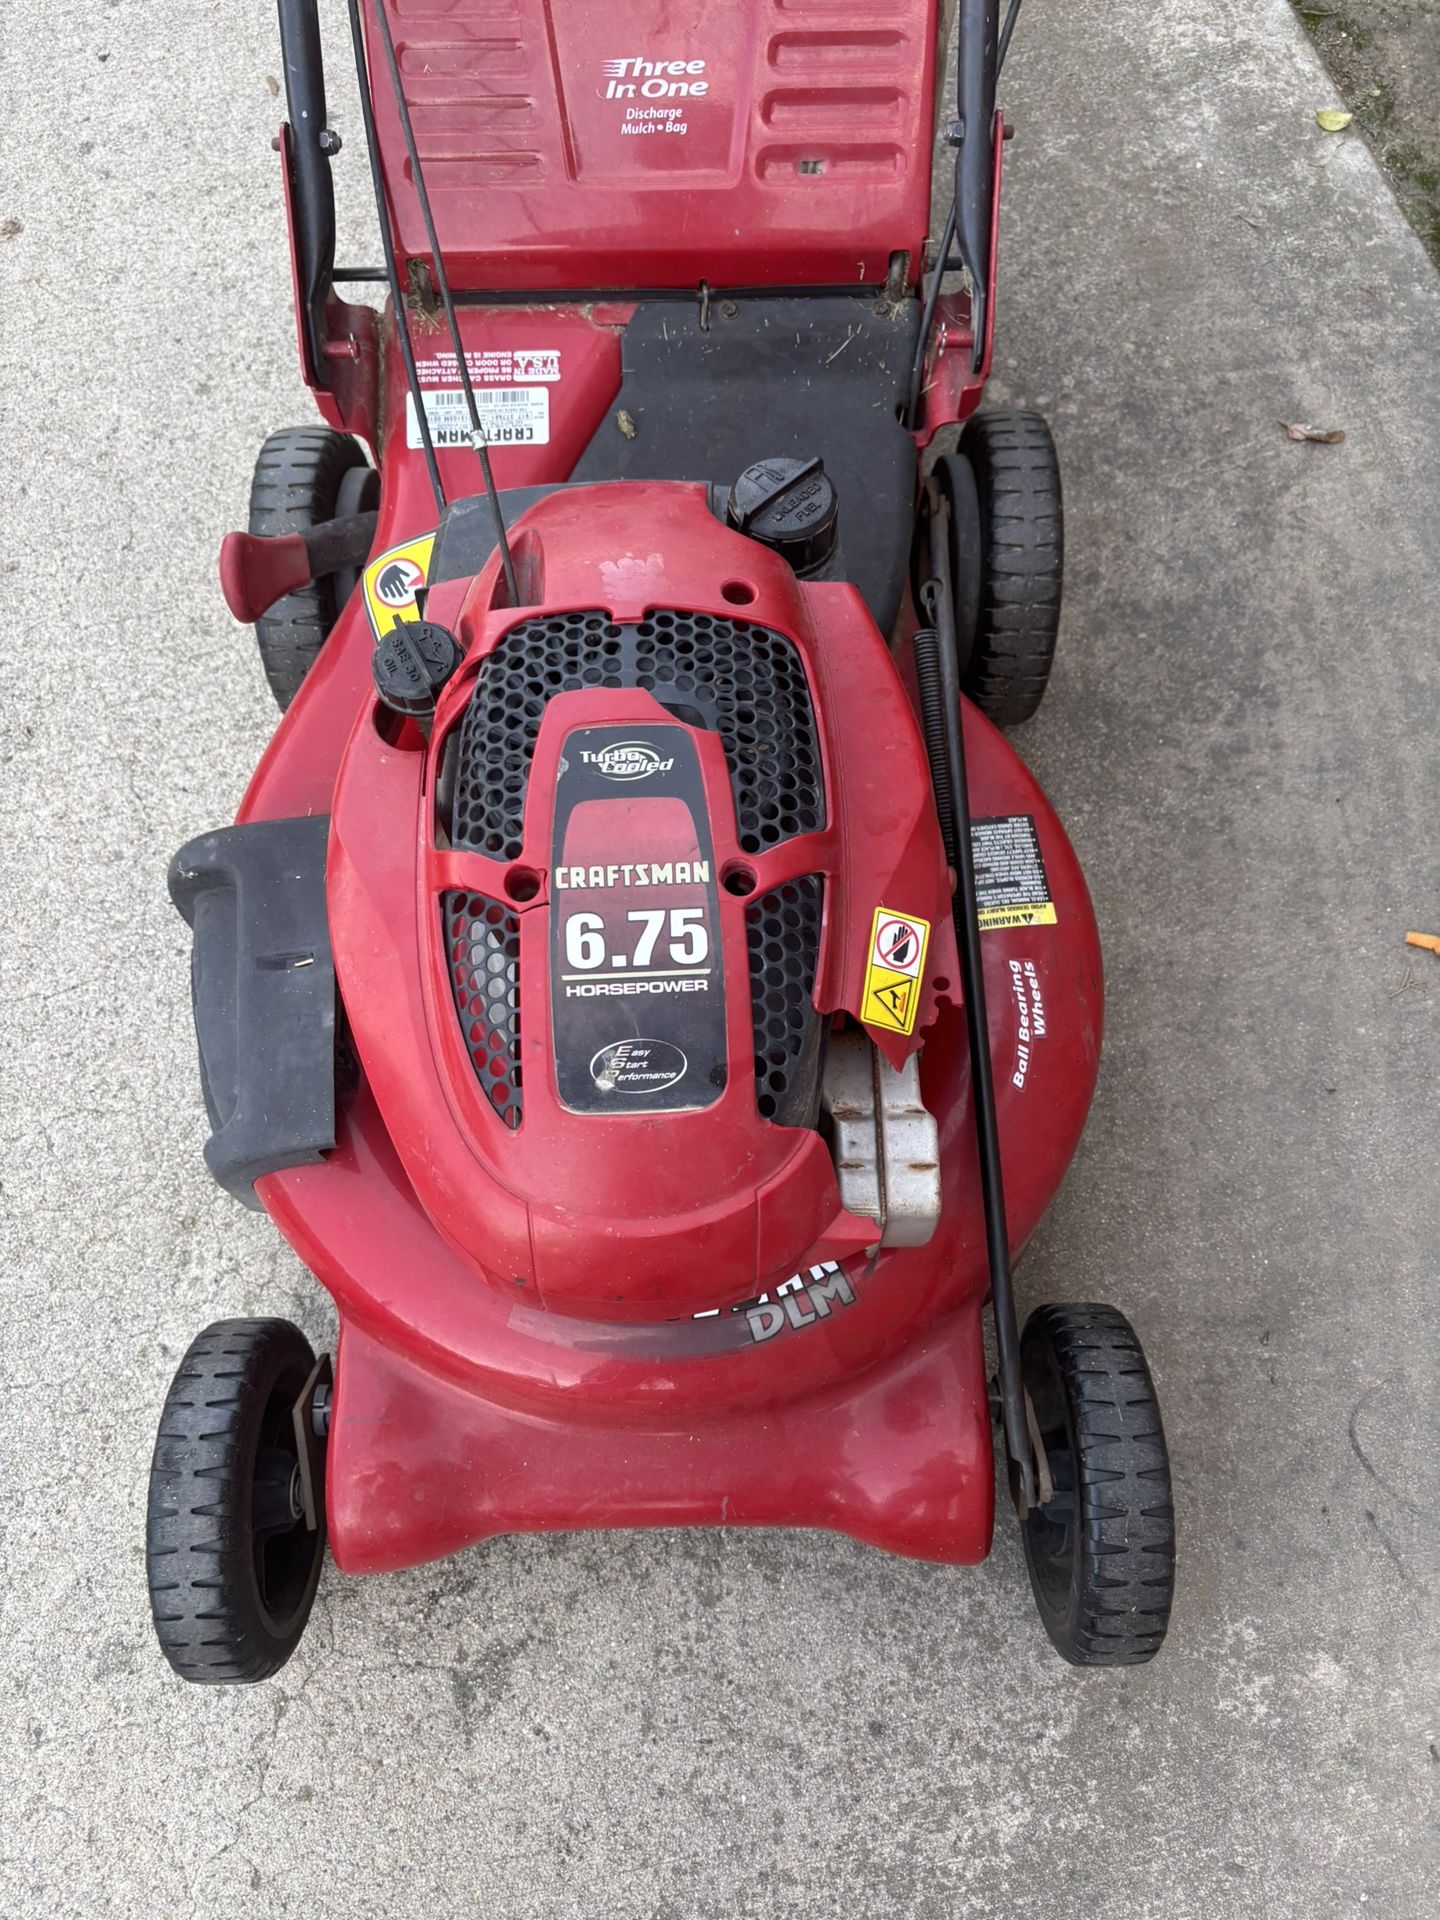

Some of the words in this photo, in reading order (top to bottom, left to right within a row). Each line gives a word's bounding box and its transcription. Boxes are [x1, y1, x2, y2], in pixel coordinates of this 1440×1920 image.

[601, 57, 706, 78] Three
[605, 80, 636, 99] In
[641, 79, 709, 98] One
[626, 107, 682, 121] Discharge
[621, 122, 655, 135] Mulch
[665, 121, 687, 135] Bag
[475, 359, 499, 367] DOOR
[484, 351, 512, 359] ENGINE
[484, 374, 512, 382] GRASS
[515, 367, 526, 376] IN
[529, 366, 559, 375] MADE
[437, 427, 533, 443] CRAFTMAN
[772, 482, 822, 521] UNLEADED
[795, 502, 822, 522] FUEL
[392, 638, 411, 664] SAE
[384, 659, 398, 679] OIL
[579, 750, 641, 764] Turbo
[599, 758, 674, 774] Cooled
[555, 860, 710, 889] CRAFTSMAN
[565, 908, 709, 969] 6.75
[566, 979, 708, 997] HORSEPOWER
[1009, 960, 1030, 1042] Bearing
[1024, 961, 1046, 1035] Wheels
[616, 1045, 651, 1057] Easy
[611, 1057, 648, 1069] Start
[1013, 1044, 1029, 1088] Ball
[746, 1269, 855, 1342] DLM
